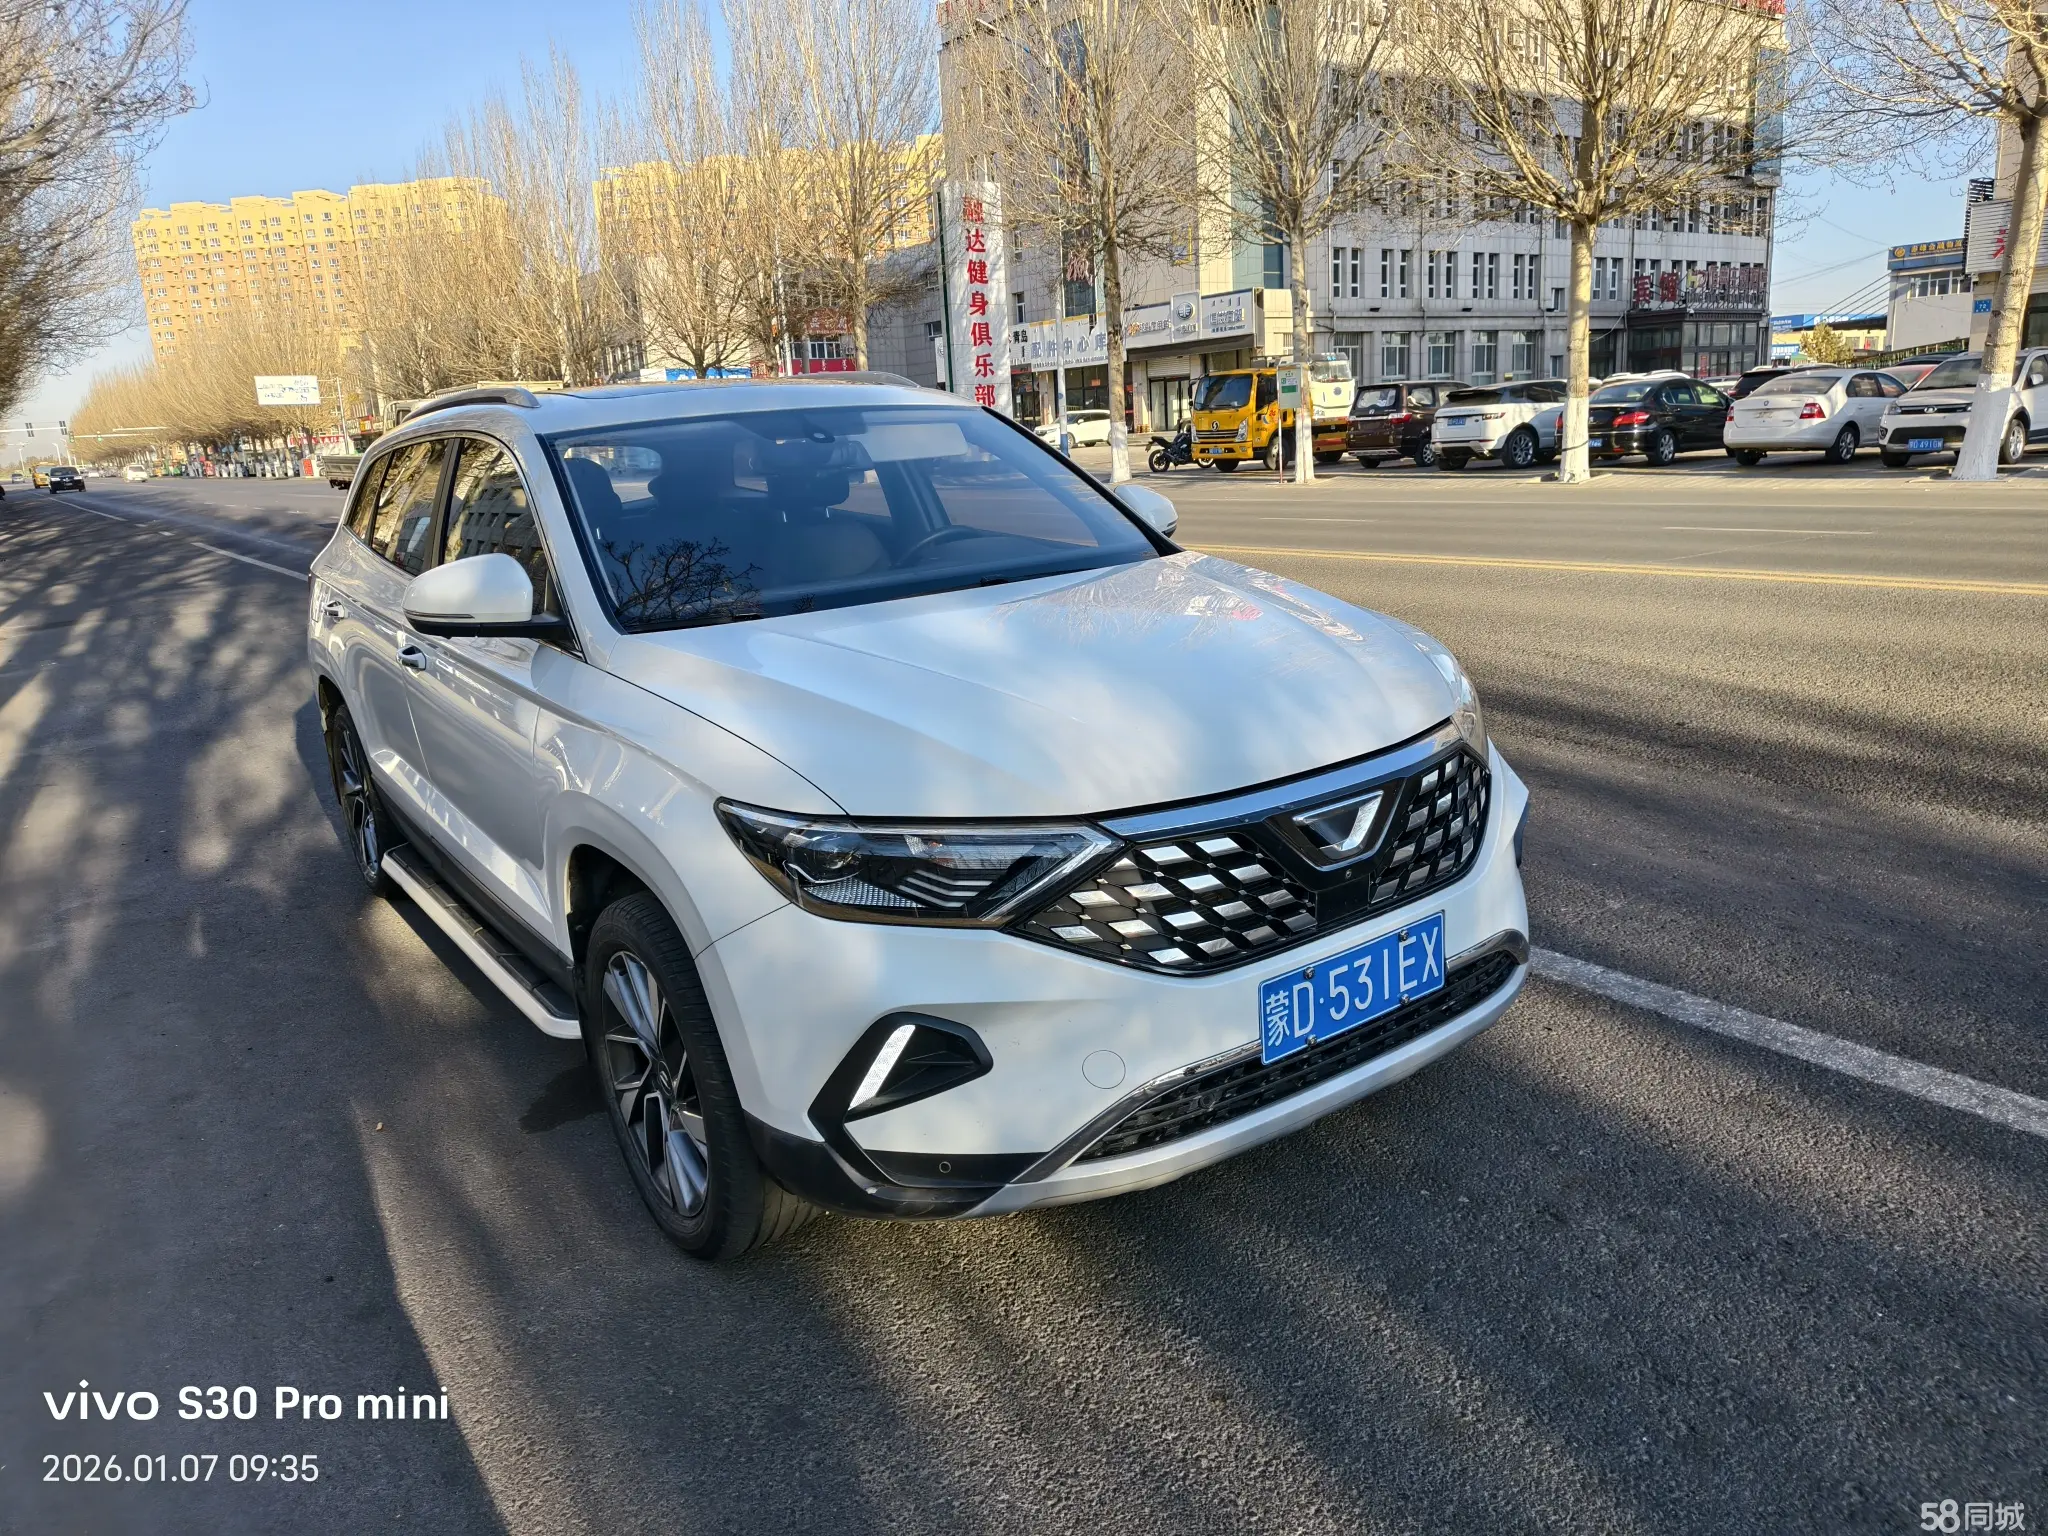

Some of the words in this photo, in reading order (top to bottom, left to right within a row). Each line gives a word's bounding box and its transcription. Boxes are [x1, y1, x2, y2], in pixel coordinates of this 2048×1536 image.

[962, 194, 996, 407] 融达健身俱乐部
